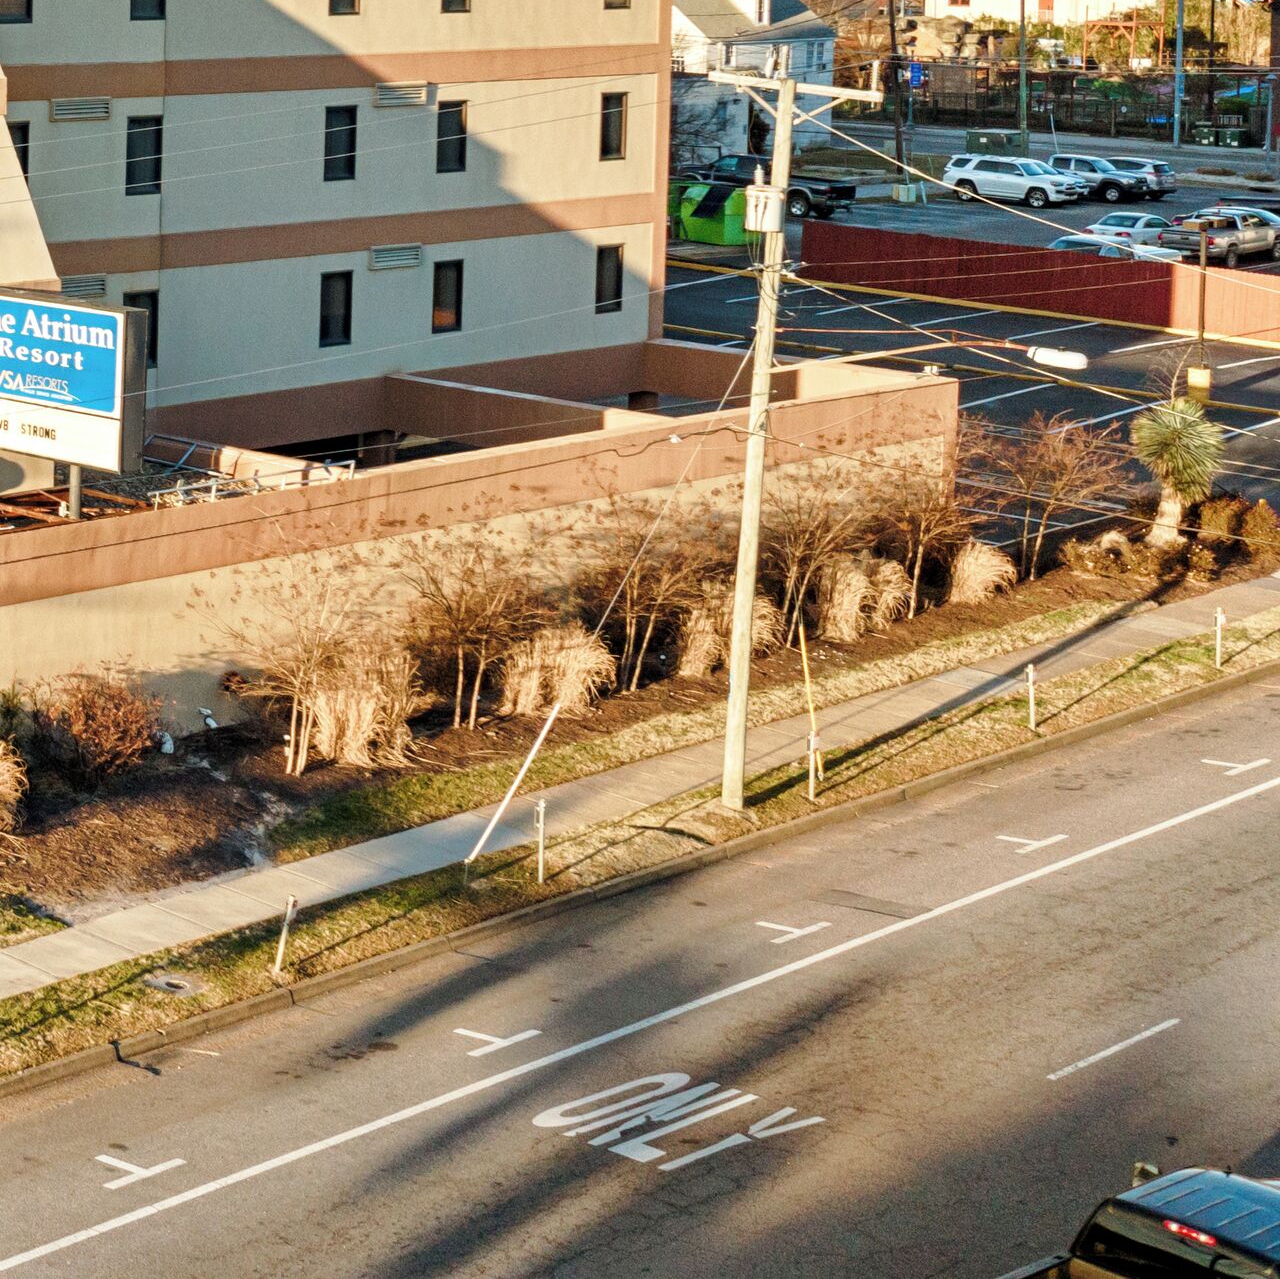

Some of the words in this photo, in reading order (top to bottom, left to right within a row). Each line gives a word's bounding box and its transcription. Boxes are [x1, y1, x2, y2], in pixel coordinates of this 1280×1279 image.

[21, 309, 115, 350] Atrium
[25, 374, 69, 394] RESORTS
[21, 423, 56, 440] STRONG
[532, 1072, 826, 1171] ONLY
